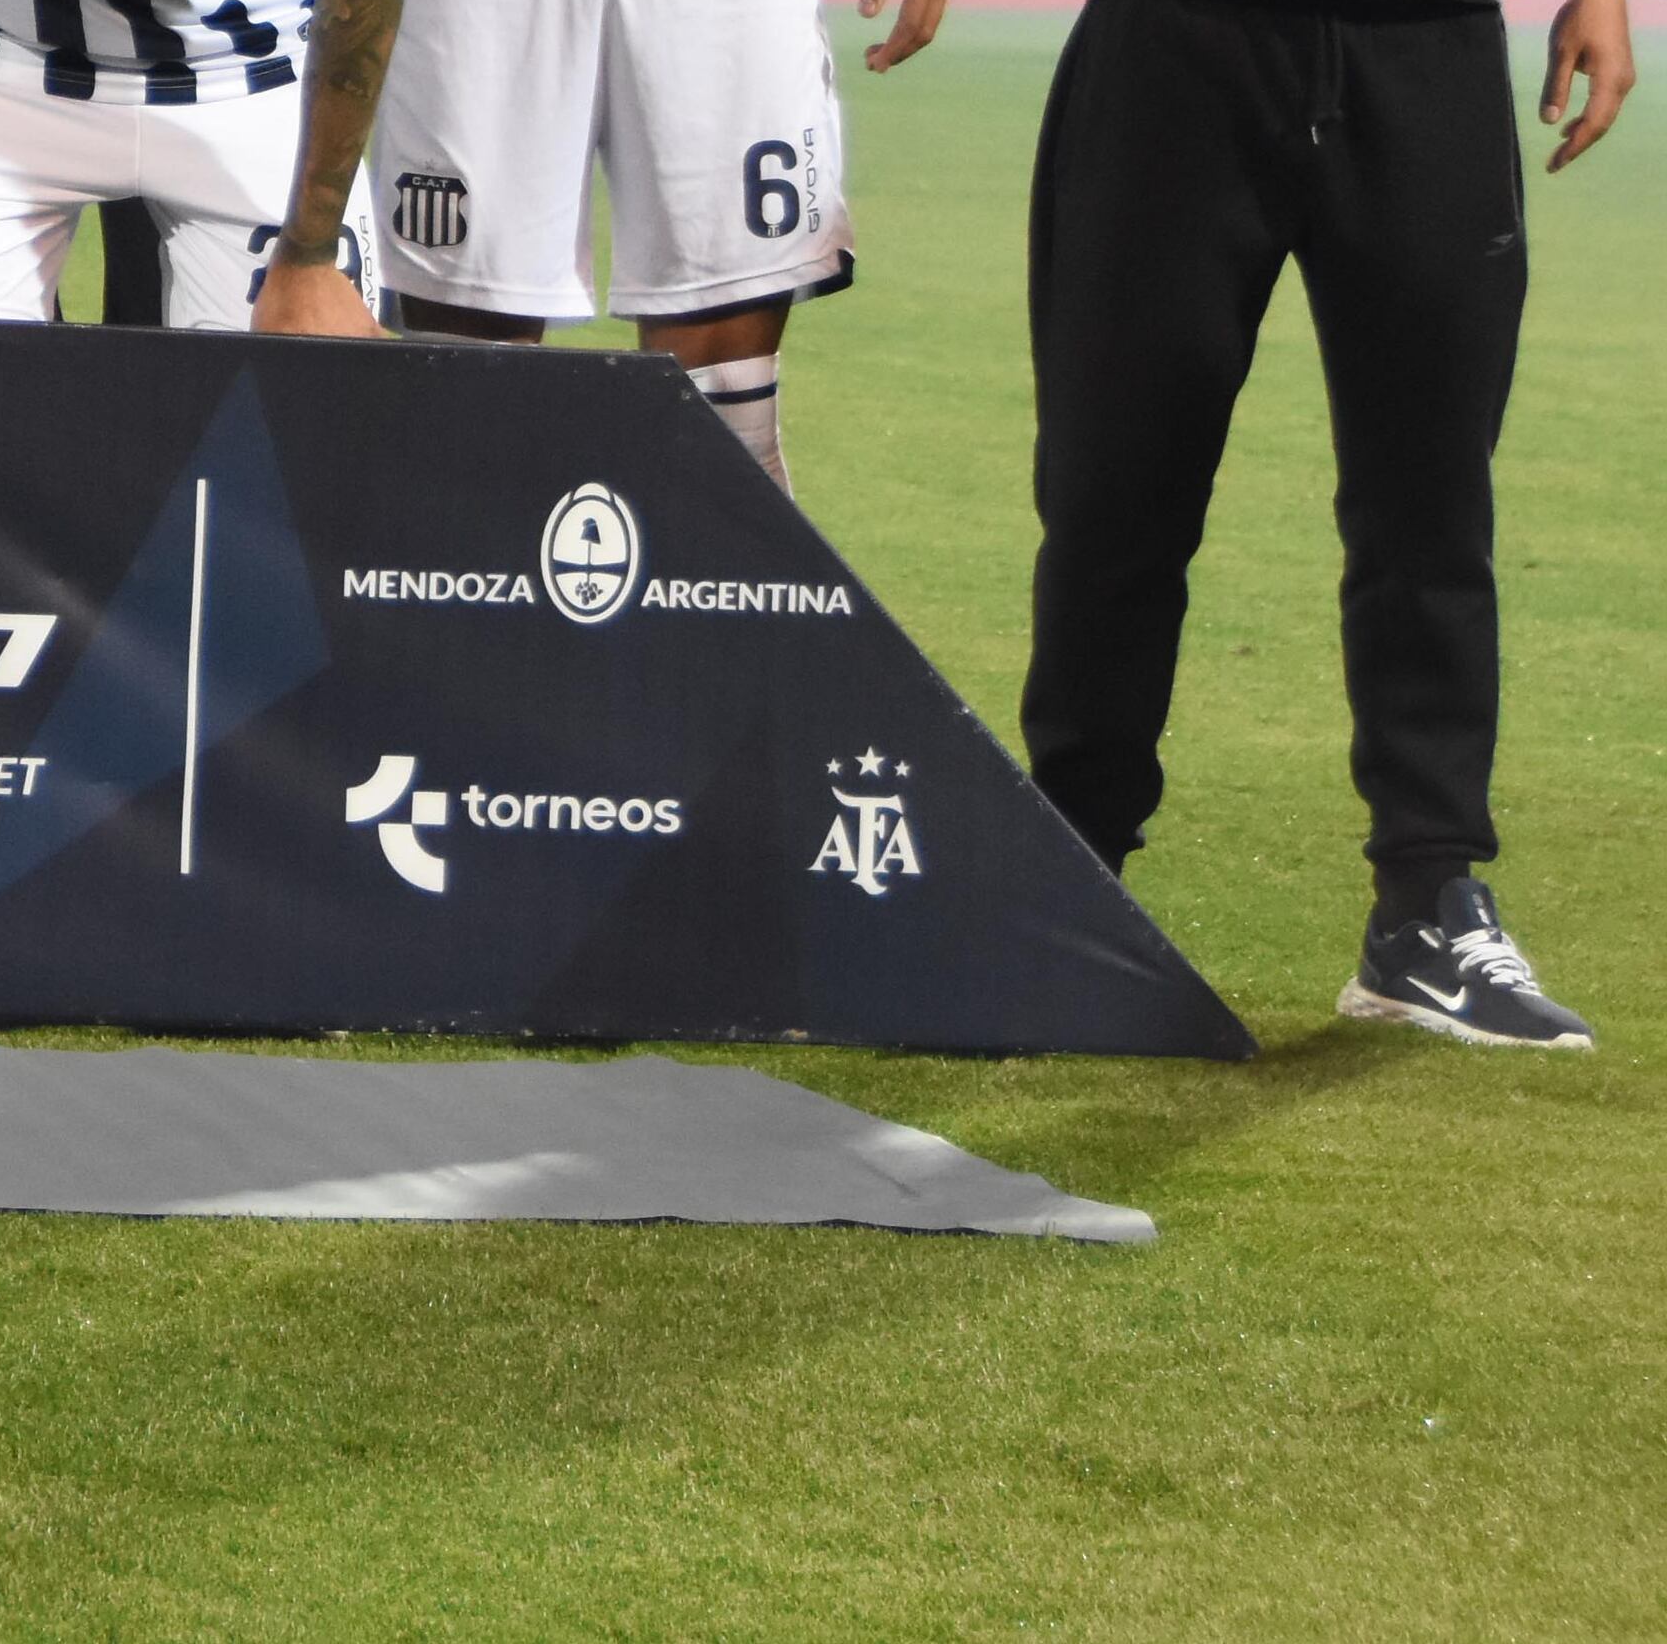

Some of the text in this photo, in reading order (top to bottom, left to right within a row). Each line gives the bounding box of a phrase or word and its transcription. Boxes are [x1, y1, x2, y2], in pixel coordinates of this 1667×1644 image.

[412, 175, 449, 188] C.A.T
[743, 139, 800, 239] 6
[803, 128, 820, 233] GIVOVA
[343, 569, 852, 615] MENDOZA ARGENTINA
[461, 784, 682, 834] torneos
